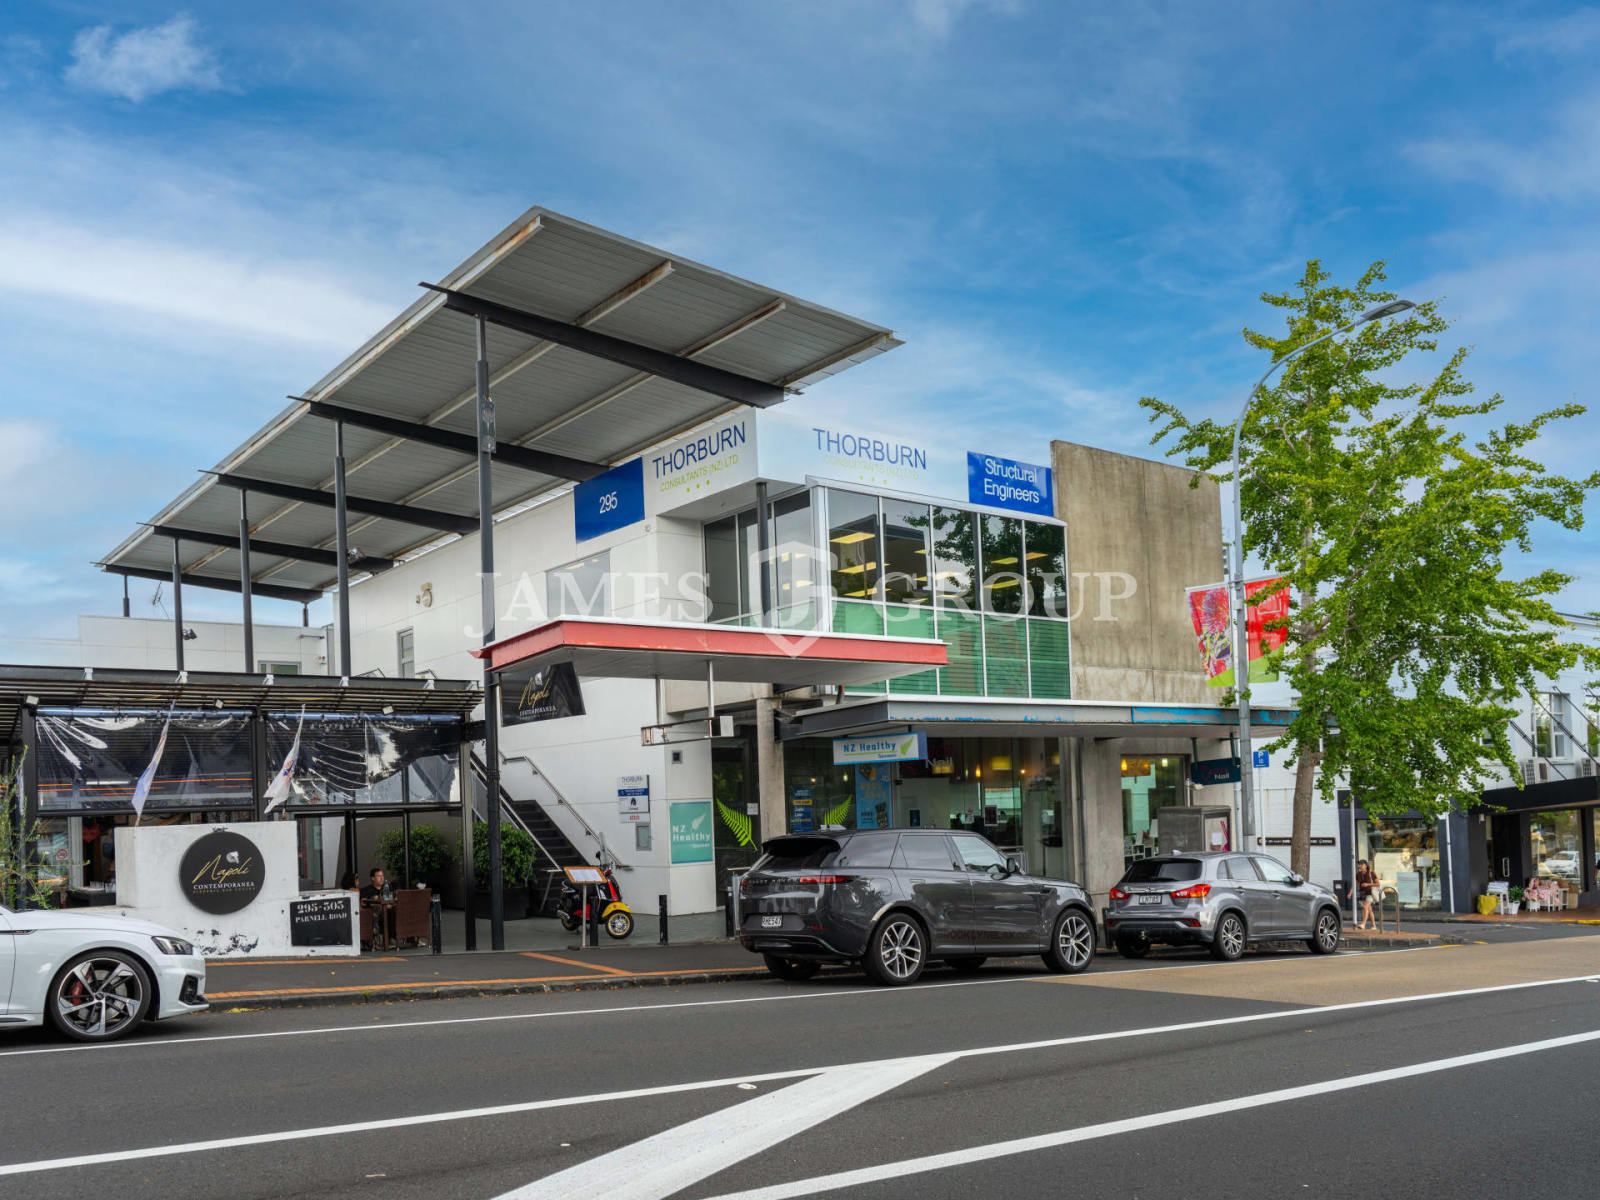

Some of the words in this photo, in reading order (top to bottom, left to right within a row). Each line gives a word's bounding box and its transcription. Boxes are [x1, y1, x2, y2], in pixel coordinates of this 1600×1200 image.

[652, 421, 746, 479] THORBURN
[812, 427, 927, 470] THORBURN
[660, 466, 708, 492] CONSULTANTS
[725, 453, 739, 468] LTD
[985, 458, 1037, 484] Structural
[599, 491, 618, 514] 295
[984, 477, 1040, 504] Engineers
[843, 743, 856, 753] NZ
[860, 741, 897, 753] Healthy
[672, 824, 686, 833] NZ
[672, 831, 711, 842] Healthy
[191, 854, 252, 884] Napoli
[193, 881, 255, 890] CONTEMPORANEA
[295, 914, 328, 924] PARNELL
[329, 912, 347, 920] ROAD
